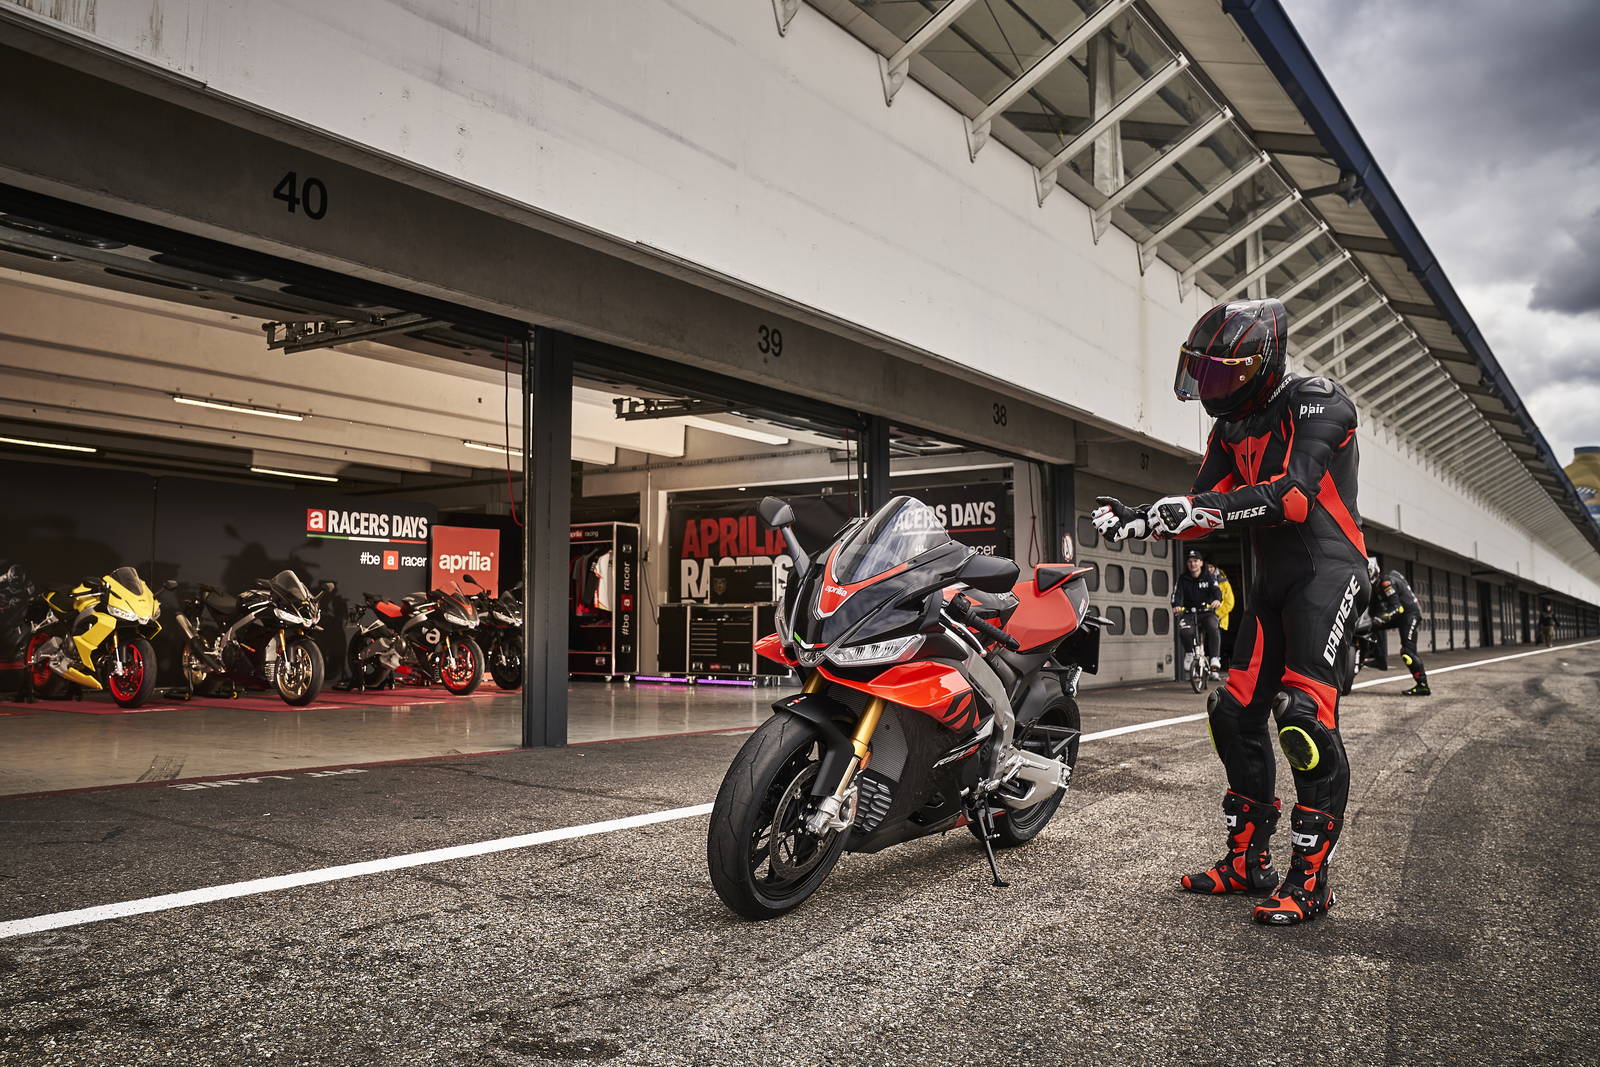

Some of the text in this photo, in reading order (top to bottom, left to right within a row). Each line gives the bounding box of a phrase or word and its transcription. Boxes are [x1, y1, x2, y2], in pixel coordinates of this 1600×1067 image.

[273, 171, 328, 220] 40
[758, 325, 782, 357] 39
[993, 403, 1008, 426] 38
[328, 510, 389, 537] RACERS
[392, 515, 428, 539] DAYS
[951, 501, 996, 527] DAYS
[360, 551, 427, 567] #be a racer
[439, 551, 491, 574] aprilia
